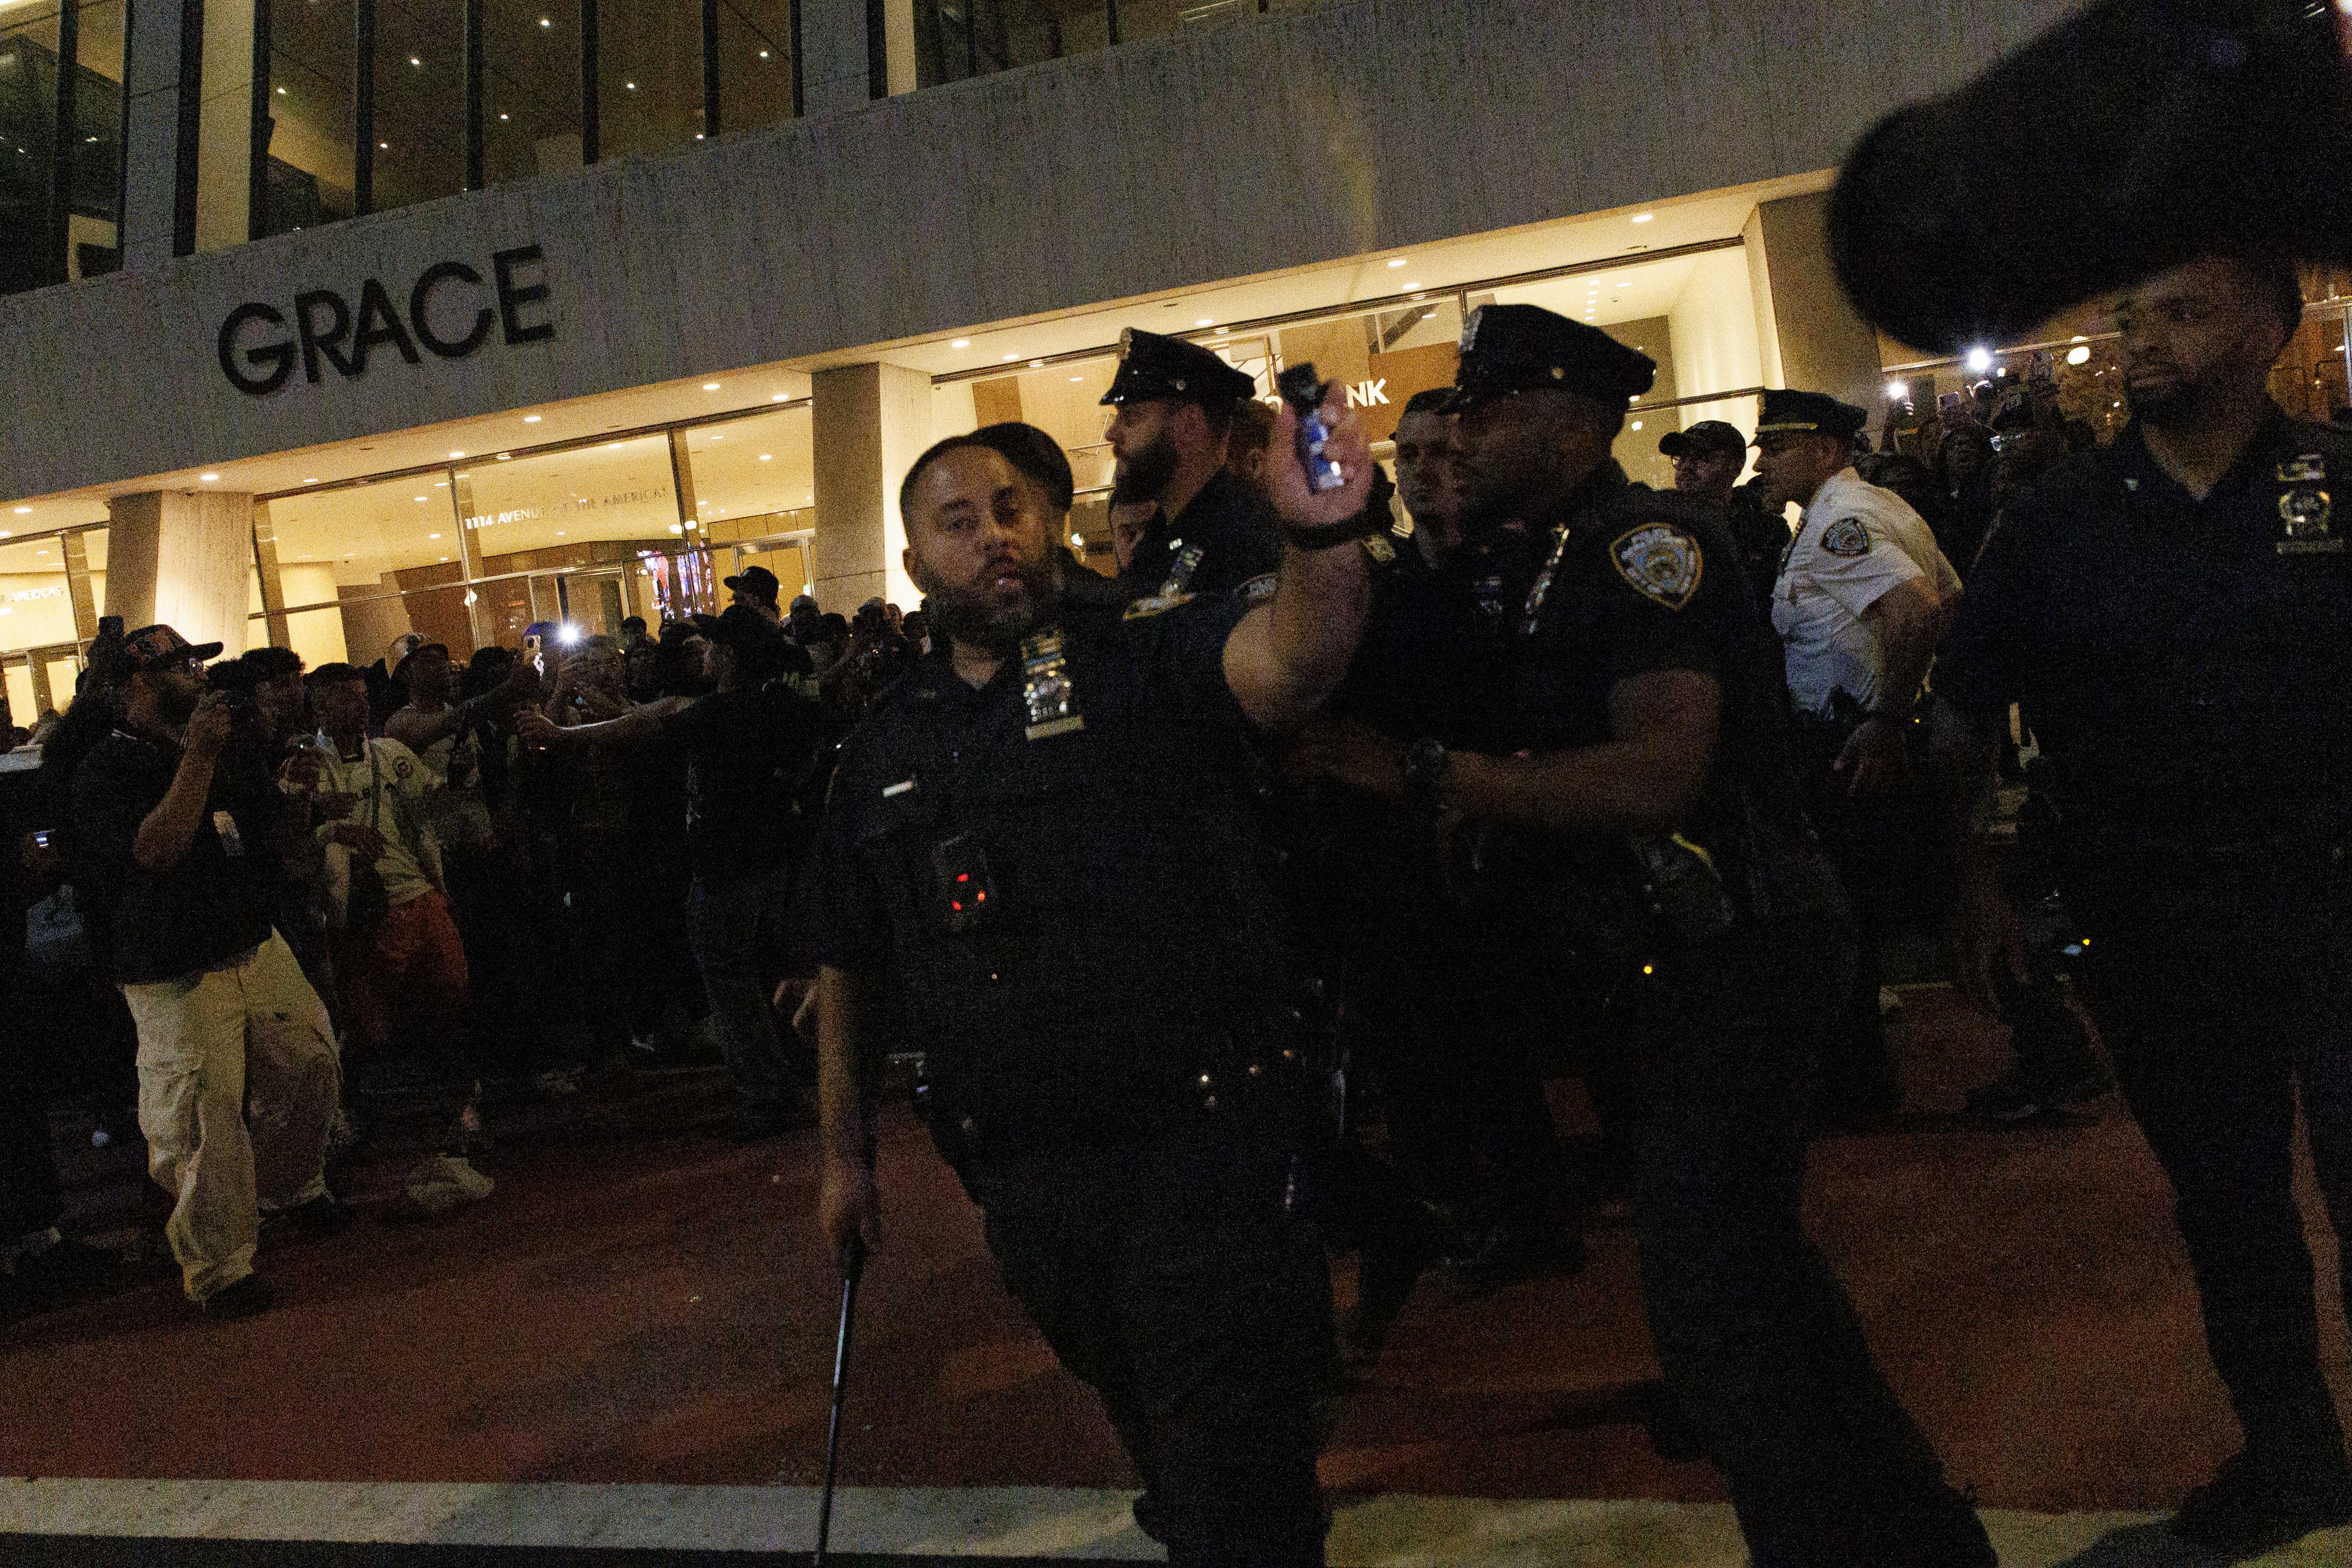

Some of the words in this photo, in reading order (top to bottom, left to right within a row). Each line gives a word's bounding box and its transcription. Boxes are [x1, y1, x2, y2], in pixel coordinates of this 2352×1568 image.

[217, 244, 556, 396] GRACE
[1345, 378, 1390, 409] NK
[465, 515, 494, 530] 1114
[498, 506, 545, 524] AVENUE
